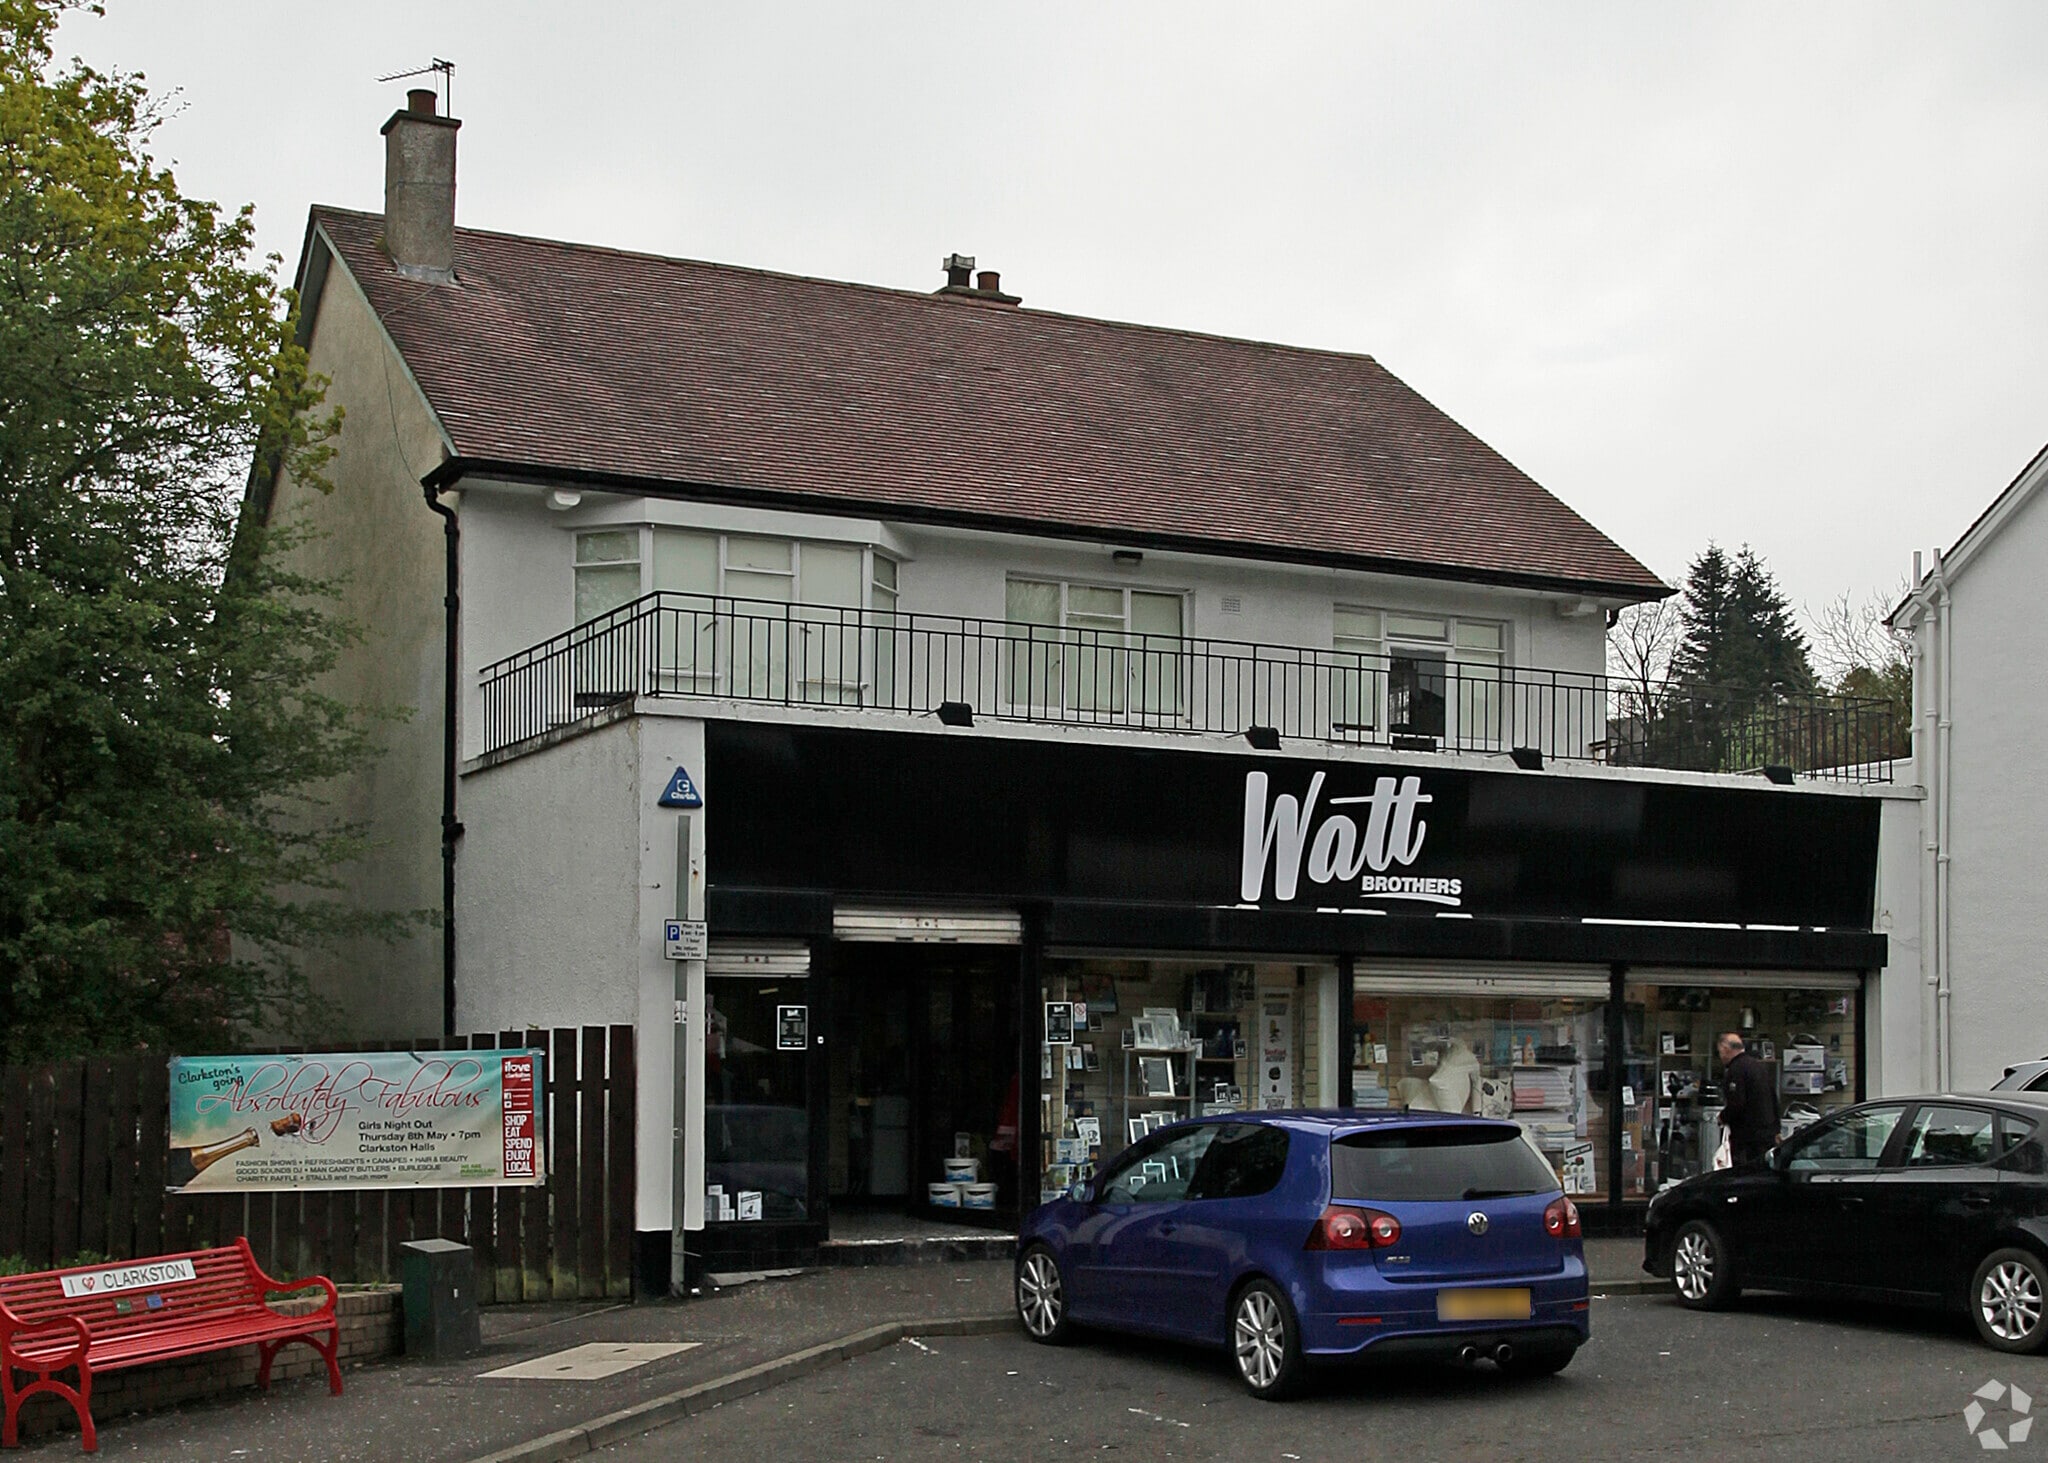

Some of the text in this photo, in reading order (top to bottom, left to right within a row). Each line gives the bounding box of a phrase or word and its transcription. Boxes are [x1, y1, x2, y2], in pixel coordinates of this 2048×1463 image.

[1241, 770, 1433, 903] Watt
[1361, 875, 1462, 896] BROTHERS
[669, 926, 679, 940] P
[178, 1064, 241, 1084] Clarkston's
[213, 1074, 245, 1091] going
[196, 1059, 490, 1144] Absolutely Fabulous
[358, 1119, 433, 1131] Girls Night Out
[504, 1115, 528, 1126] SHOP
[358, 1130, 481, 1143] Thursday 8th May 7pm
[505, 1126, 521, 1138] EAT
[358, 1142, 436, 1153] Clarkston Halls
[505, 1138, 533, 1149] SPEND
[439, 1155, 469, 1163] BEAUTY
[505, 1149, 532, 1161] ENJOY
[235, 1167, 259, 1175] GOOD
[356, 1165, 391, 1173] BUTLERS
[506, 1161, 533, 1172] LOCAL
[102, 1262, 187, 1290] CLARKSTON
